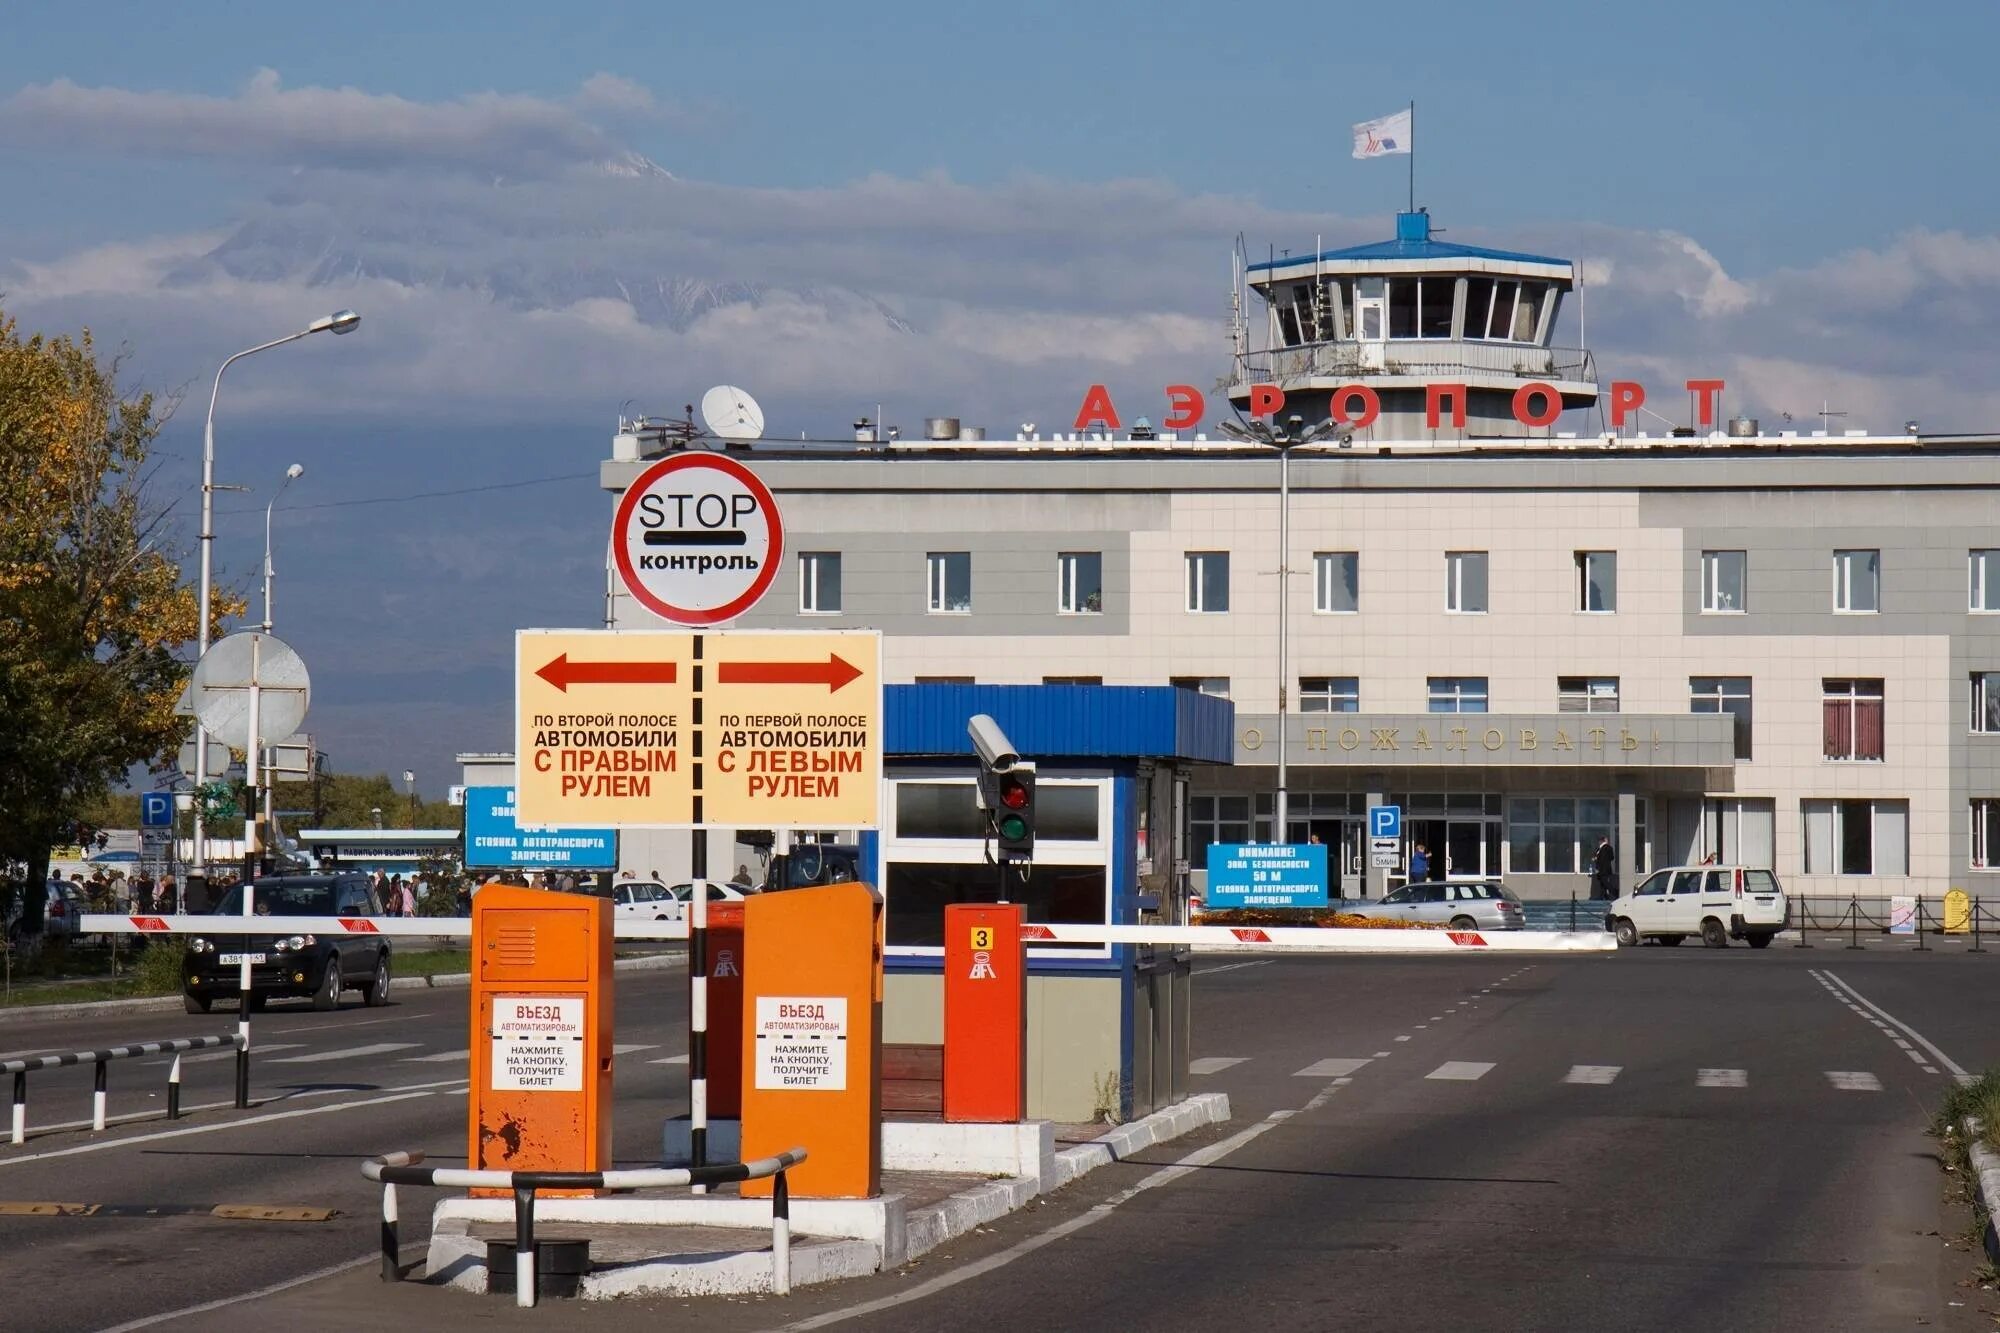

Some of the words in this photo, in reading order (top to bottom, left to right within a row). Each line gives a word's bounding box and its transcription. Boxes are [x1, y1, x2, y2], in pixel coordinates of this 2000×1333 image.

[1073, 380, 1725, 430] АЭРОПОРТ
[639, 494, 757, 528] STOP
[640, 555, 758, 574] контроль
[534, 714, 553, 727] ПО
[558, 712, 614, 727] ВТОРОЙ
[619, 714, 677, 727] ПОЛОСЕ
[720, 714, 740, 727] ПО
[745, 712, 802, 727] ПЕРВОЙ
[807, 714, 867, 727] ПОЛОСЕ
[534, 730, 677, 747] АВТОМОБИЛИ
[720, 730, 866, 748] АВТОМОБИЛИ
[1306, 727, 1662, 752] ПОЖАЛОВАТЬ!
[534, 749, 552, 772] С
[561, 750, 676, 772] ПРАВЫМ
[718, 749, 736, 773] С
[746, 750, 862, 773] ЛЕВЫМ
[562, 775, 650, 797] РУЛЕМ
[748, 775, 839, 798] РУЛЕМ
[148, 798, 166, 824] P
[1377, 811, 1395, 835] P
[475, 836, 517, 848] СТОЯНКА
[523, 836, 604, 848] АВТОТРАНСПОРТА
[511, 850, 570, 862] ЗАПРЕЩЕНА!
[1238, 847, 1296, 858] ВНИМАНИЕ!
[1227, 860, 1248, 869] ЗОНА
[1252, 860, 1310, 869] БЕЗОПАСНОСТИ
[1253, 871, 1267, 882] 50
[1216, 885, 1250, 894] СТОЯНКА
[1253, 884, 1319, 893] АВТОТРАНСПОРТА
[1244, 895, 1292, 905] ЗАПРЕЩЕНА!
[976, 930, 988, 947] 3
[516, 1005, 561, 1022] ВЪЕЗД
[779, 1004, 824, 1020] ВЪЕЗД
[501, 1023, 576, 1032] АВТОМАТИЗИРОВАН
[764, 1021, 840, 1031] АВТОМАТИЗИРОВАН
[511, 1046, 564, 1055] НАЖМИТЕ
[775, 1045, 828, 1054] НАЖМИТЕ
[506, 1056, 520, 1065] НА
[523, 1056, 568, 1066] КНОПКУ,
[770, 1055, 784, 1064] НА
[787, 1056, 832, 1066] КНОПКУ,
[509, 1066, 565, 1075] ПОЛУЧИТЕ
[773, 1066, 829, 1075] ПОЛУЧИТЕ
[519, 1077, 553, 1086] БИЛЕТ
[783, 1076, 818, 1085] БИЛЕТ
